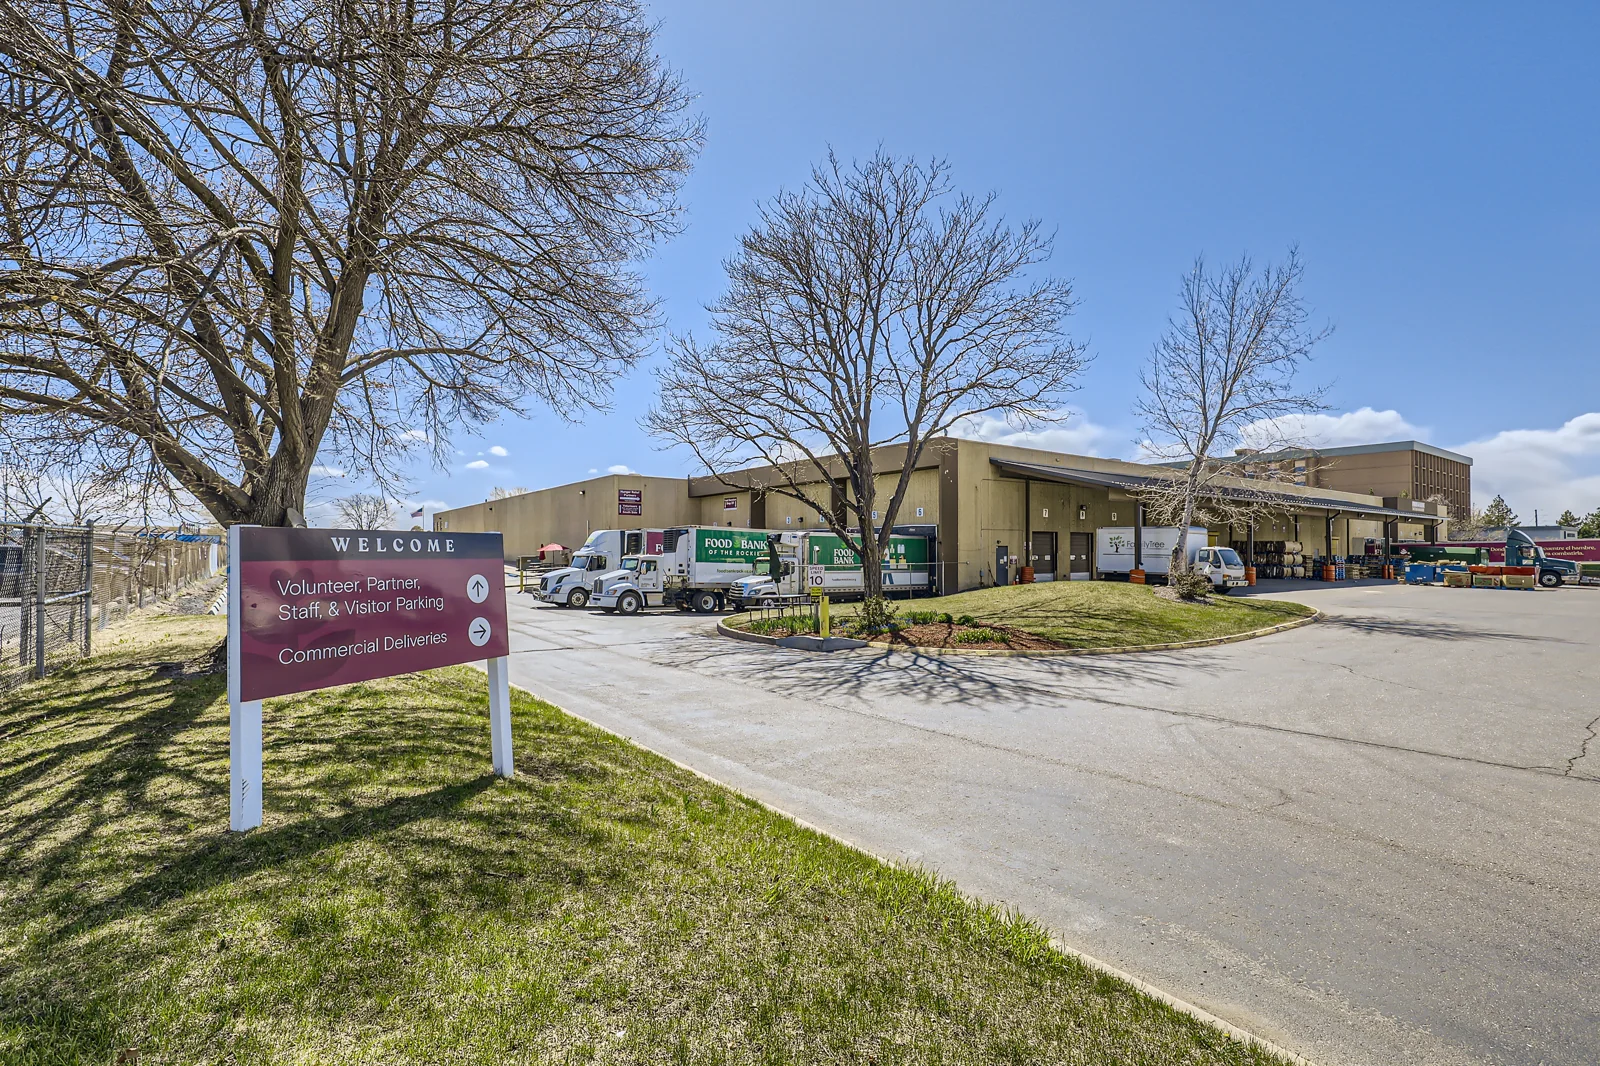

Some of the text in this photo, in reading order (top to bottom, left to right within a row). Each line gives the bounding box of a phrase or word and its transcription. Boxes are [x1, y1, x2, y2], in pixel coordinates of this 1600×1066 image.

[331, 537, 455, 552] WELCOME
[705, 538, 767, 550] FOOD BANK
[833, 548, 855, 557] FOOD
[833, 557, 855, 565] BANK
[277, 576, 421, 597] Volunteer, Partner,
[810, 576, 823, 585] 10
[278, 595, 444, 621] Staff, & Visitor Parking
[278, 631, 448, 665] Commercial Deliveries
